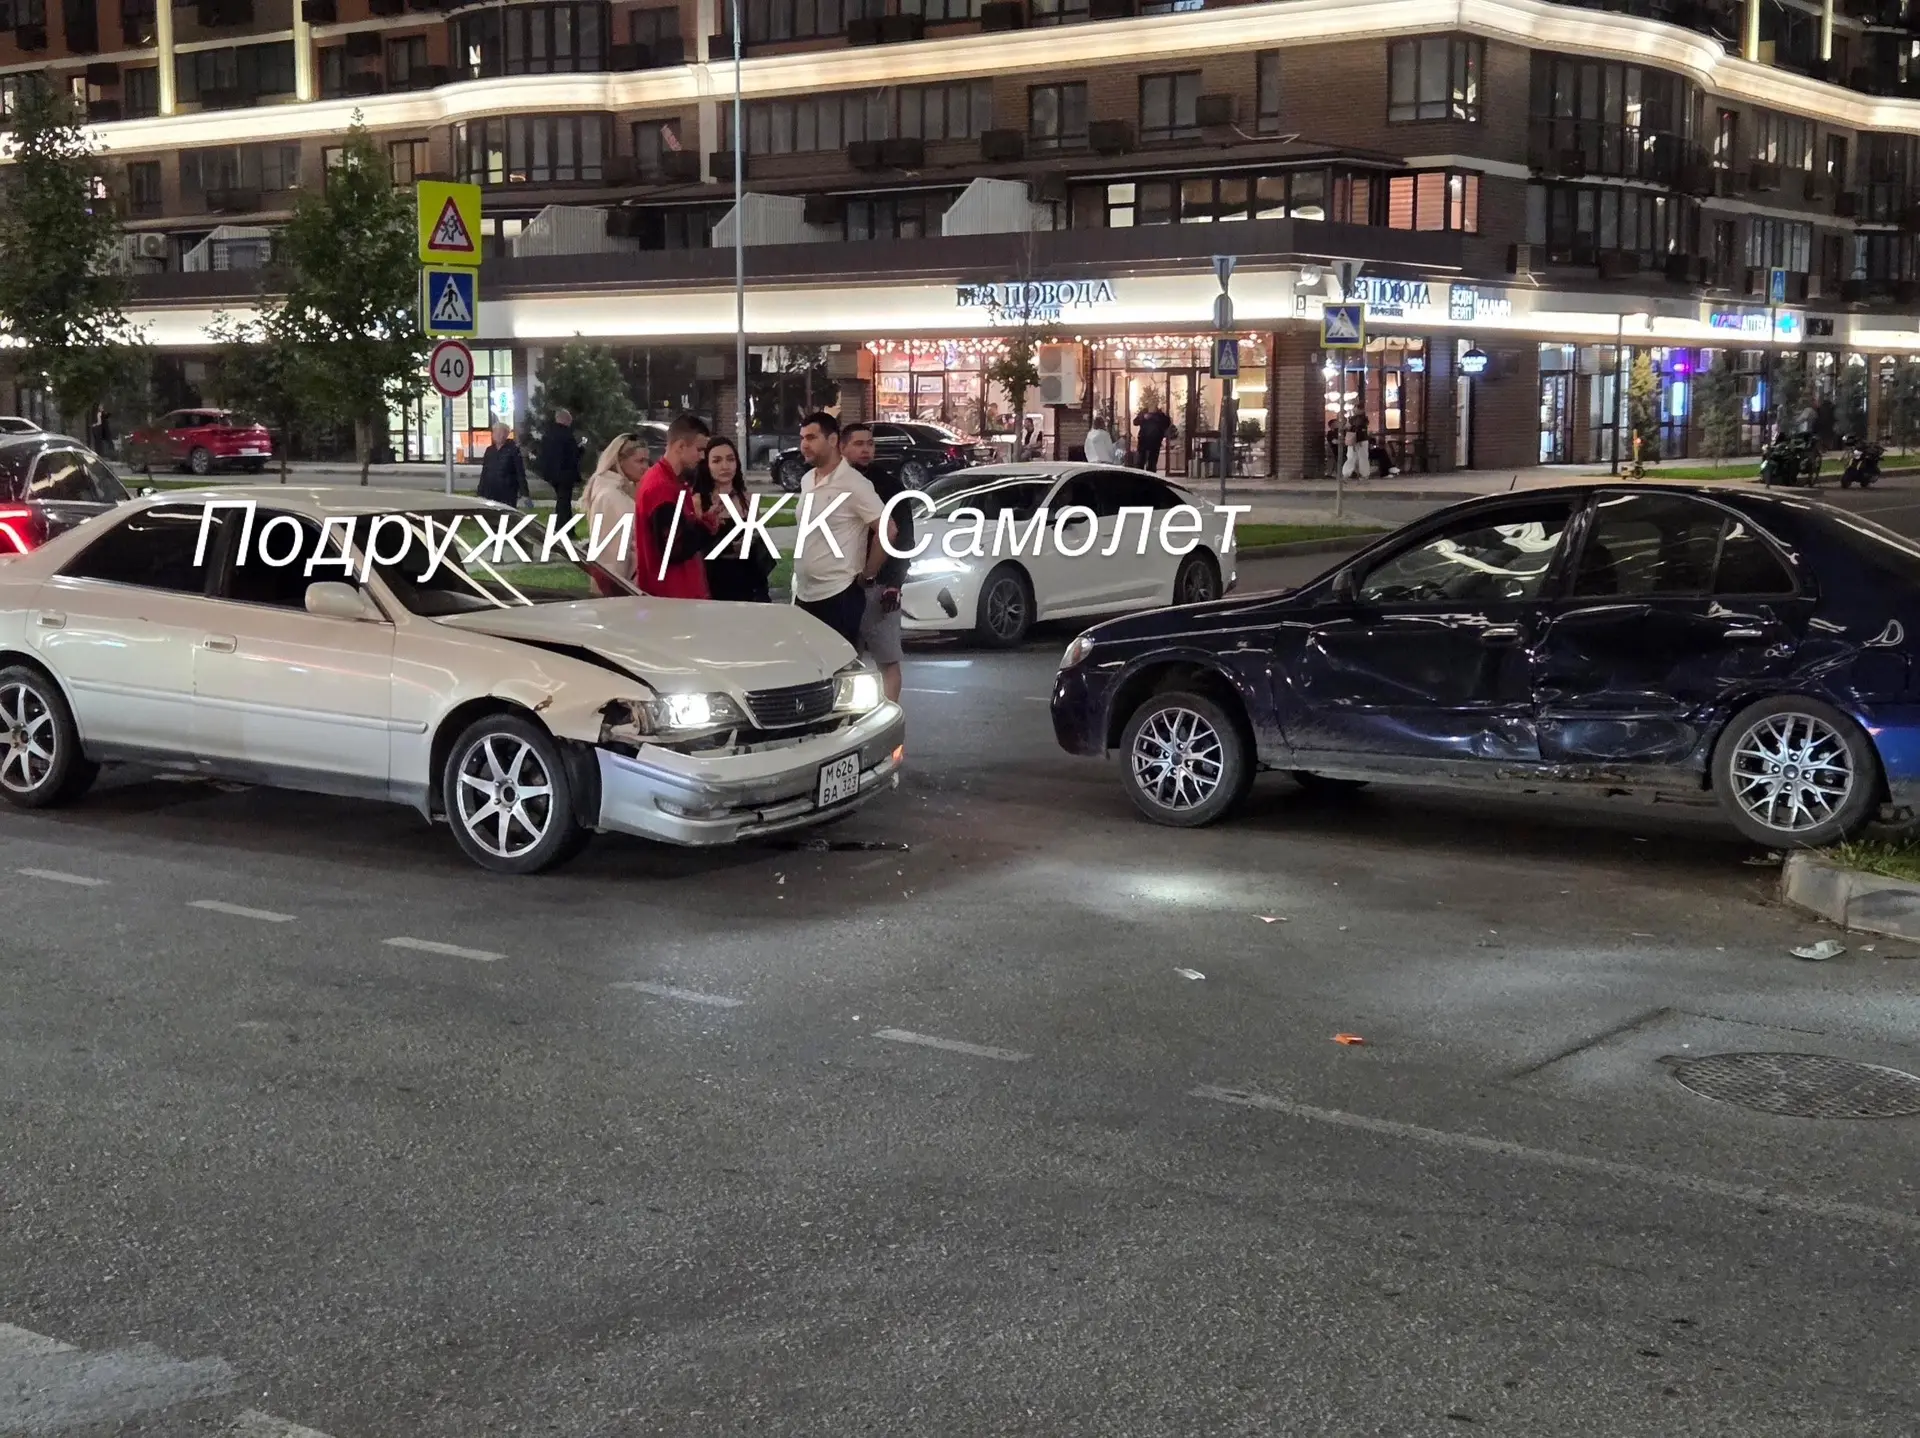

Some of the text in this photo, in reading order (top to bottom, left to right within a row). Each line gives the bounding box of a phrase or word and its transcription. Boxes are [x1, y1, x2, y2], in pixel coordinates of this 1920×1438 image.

[1004, 281, 1113, 309] ПОВОДА
[1369, 279, 1431, 309] ПОВОДА
[440, 359, 464, 378] 40
[836, 760, 853, 778] 626
